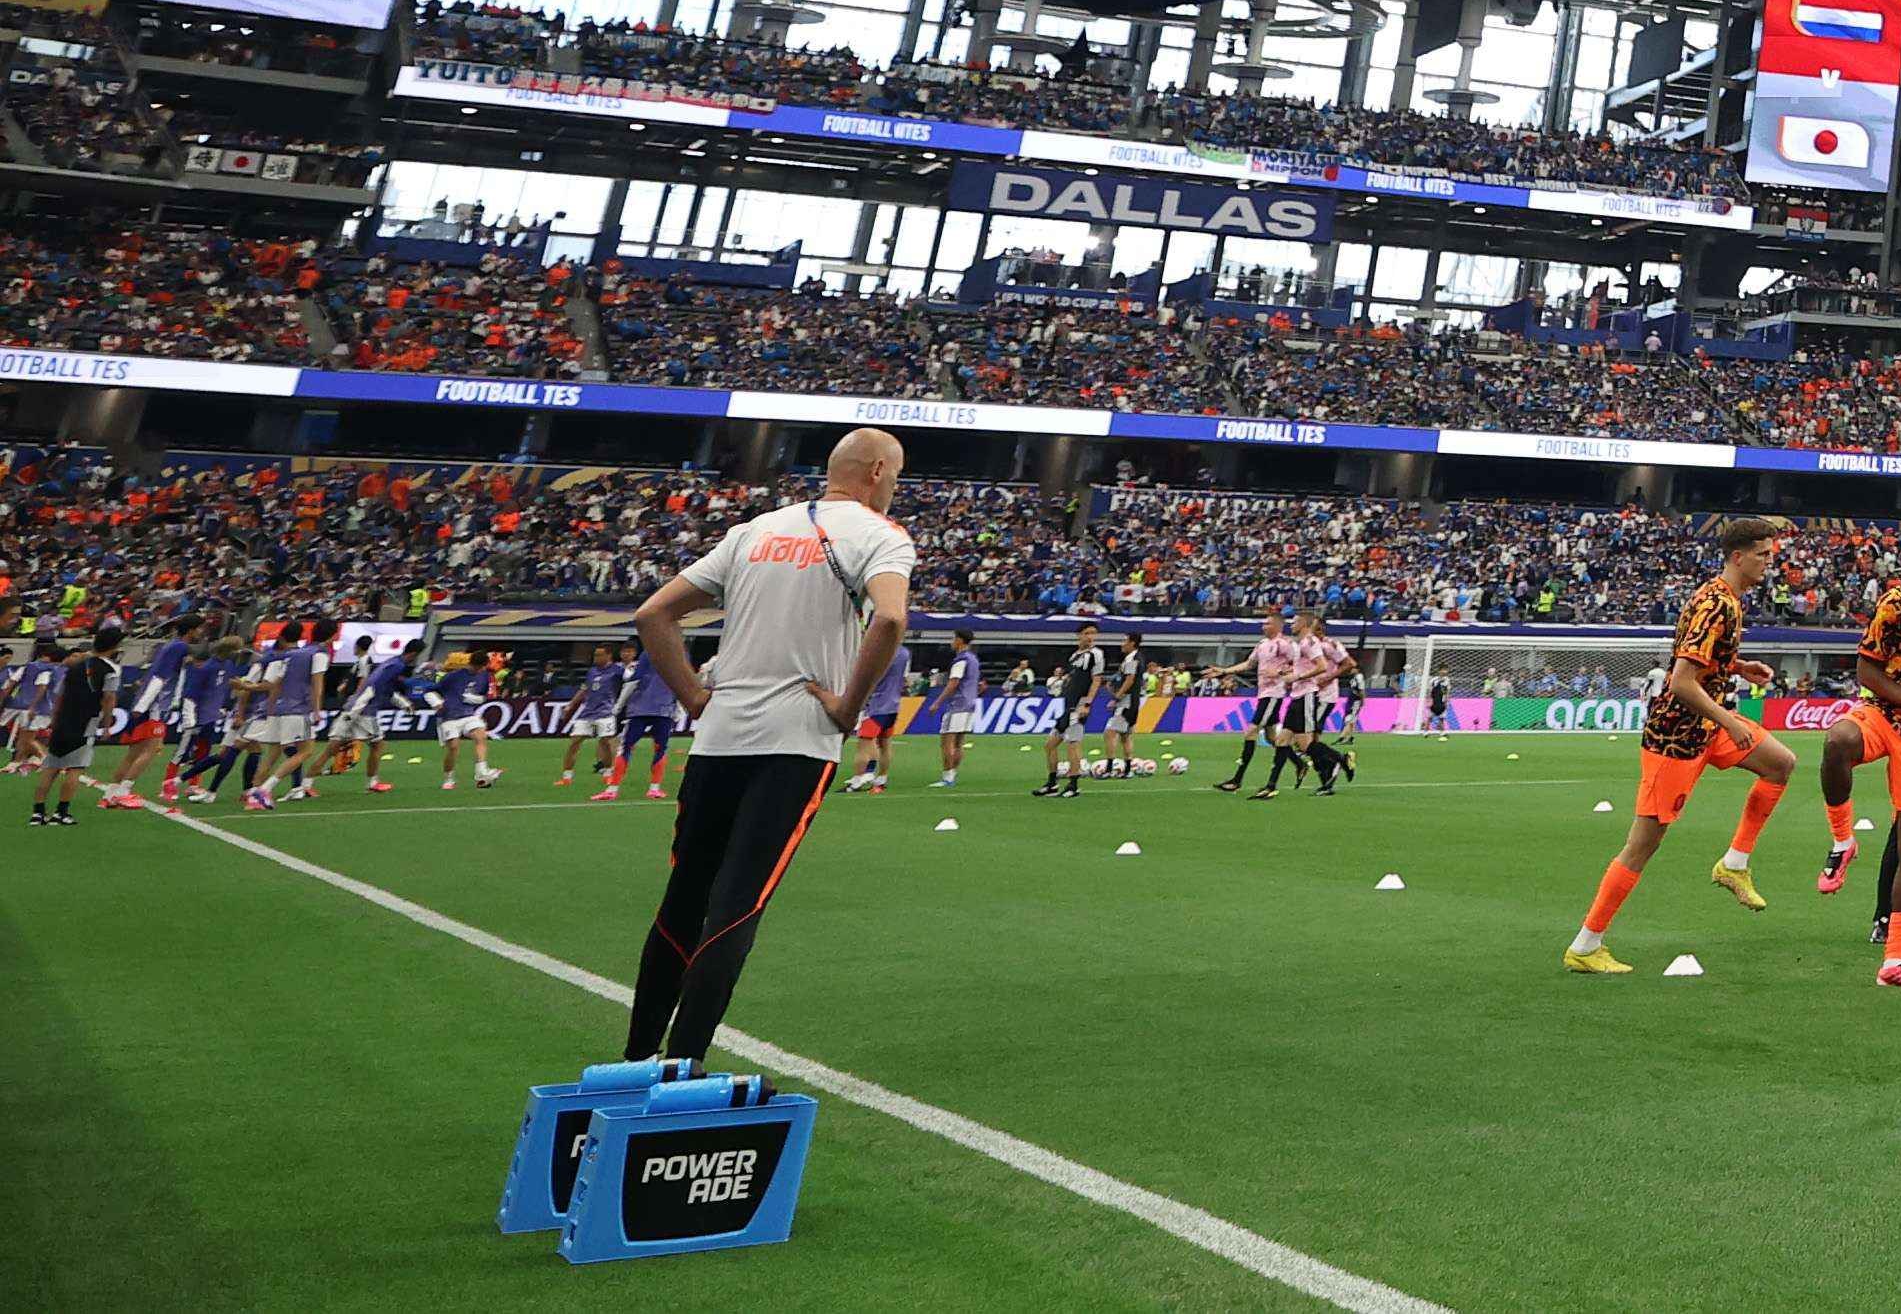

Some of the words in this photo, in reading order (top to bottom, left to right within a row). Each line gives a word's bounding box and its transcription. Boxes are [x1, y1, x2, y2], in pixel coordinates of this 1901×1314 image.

[823, 115, 892, 138] FOOTBALL
[1109, 146, 1167, 164] FOOTBALL
[989, 172, 1317, 238] DALLAS
[436, 380, 540, 405] FOOTBALL
[856, 403, 940, 424] FOOTBALL
[1216, 421, 1293, 442] FOOTBALL
[1537, 439, 1600, 456] FOOTBALL
[1819, 454, 1878, 472] FOOTBALL
[965, 697, 1065, 734] VISA
[641, 1149, 757, 1183] POWER
[687, 1175, 752, 1204] ADE
